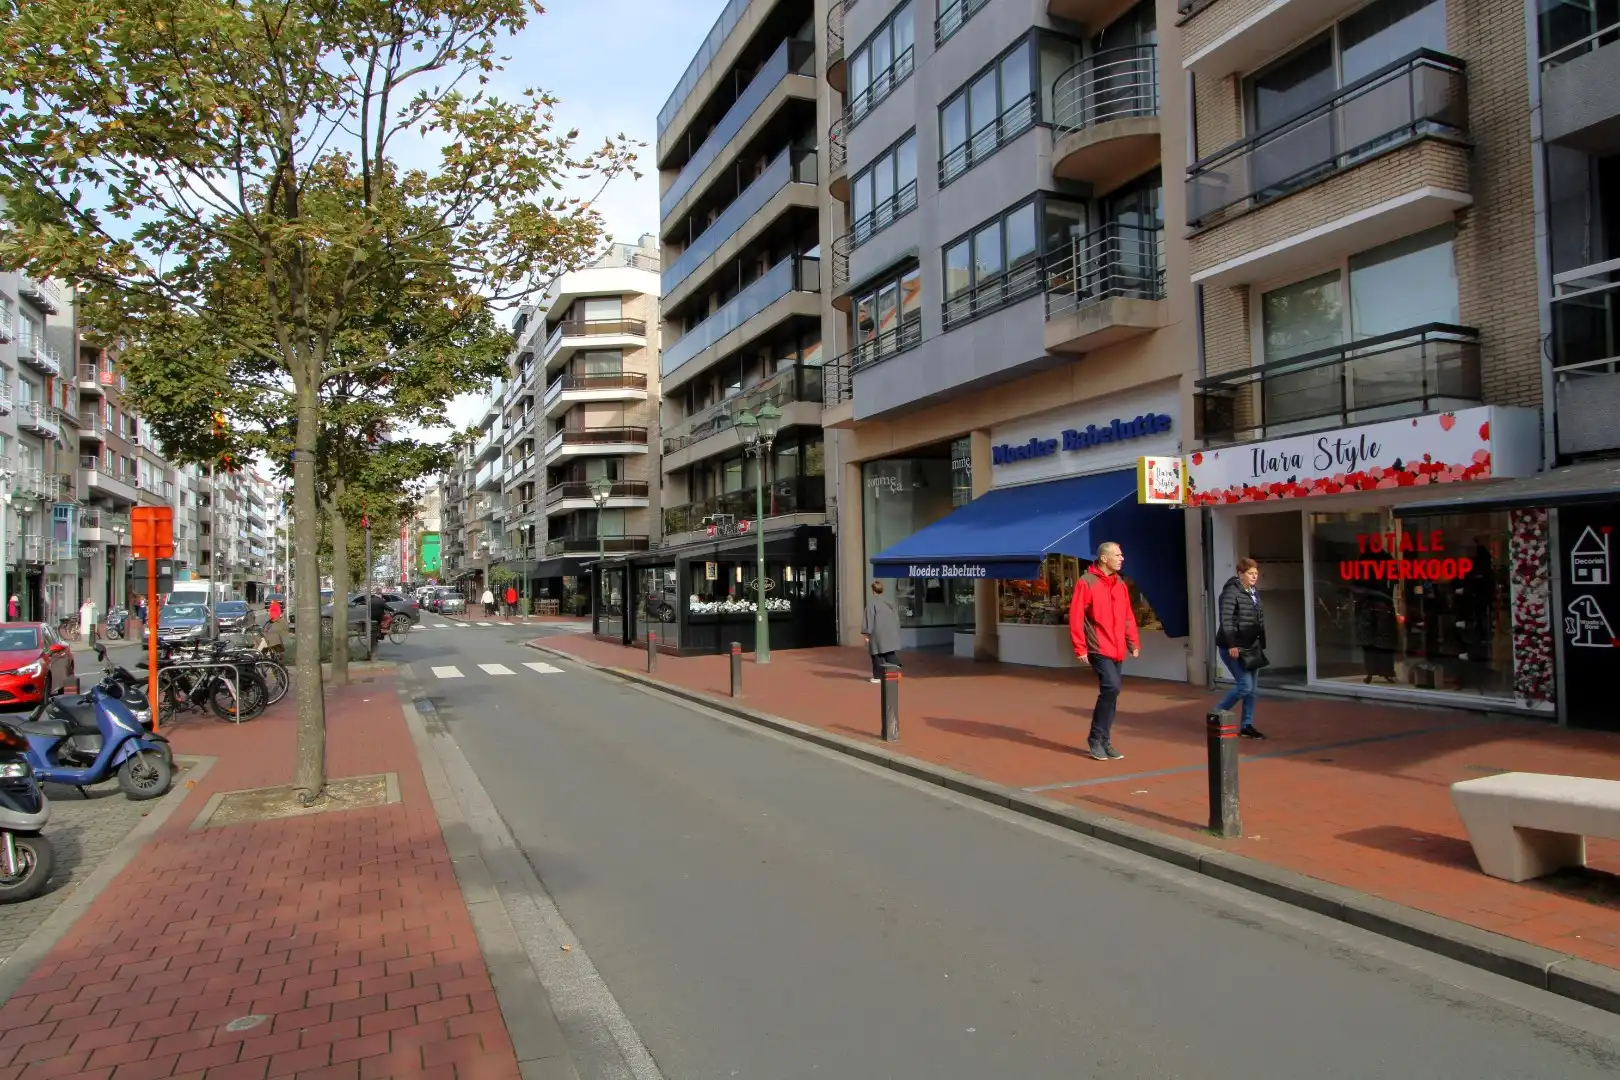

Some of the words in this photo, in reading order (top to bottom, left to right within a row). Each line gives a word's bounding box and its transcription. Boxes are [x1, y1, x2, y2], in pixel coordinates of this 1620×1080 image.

[992, 438, 1057, 465] Moeder
[1062, 412, 1172, 451] Babelutte
[1250, 447, 1303, 478] Ilara
[1313, 433, 1382, 473] Style
[867, 476, 896, 488] comme
[1355, 529, 1445, 553] TOTALE
[908, 564, 940, 577] Moeder
[941, 563, 986, 577] Babelutte
[1340, 557, 1473, 580] UITVERKOOP
